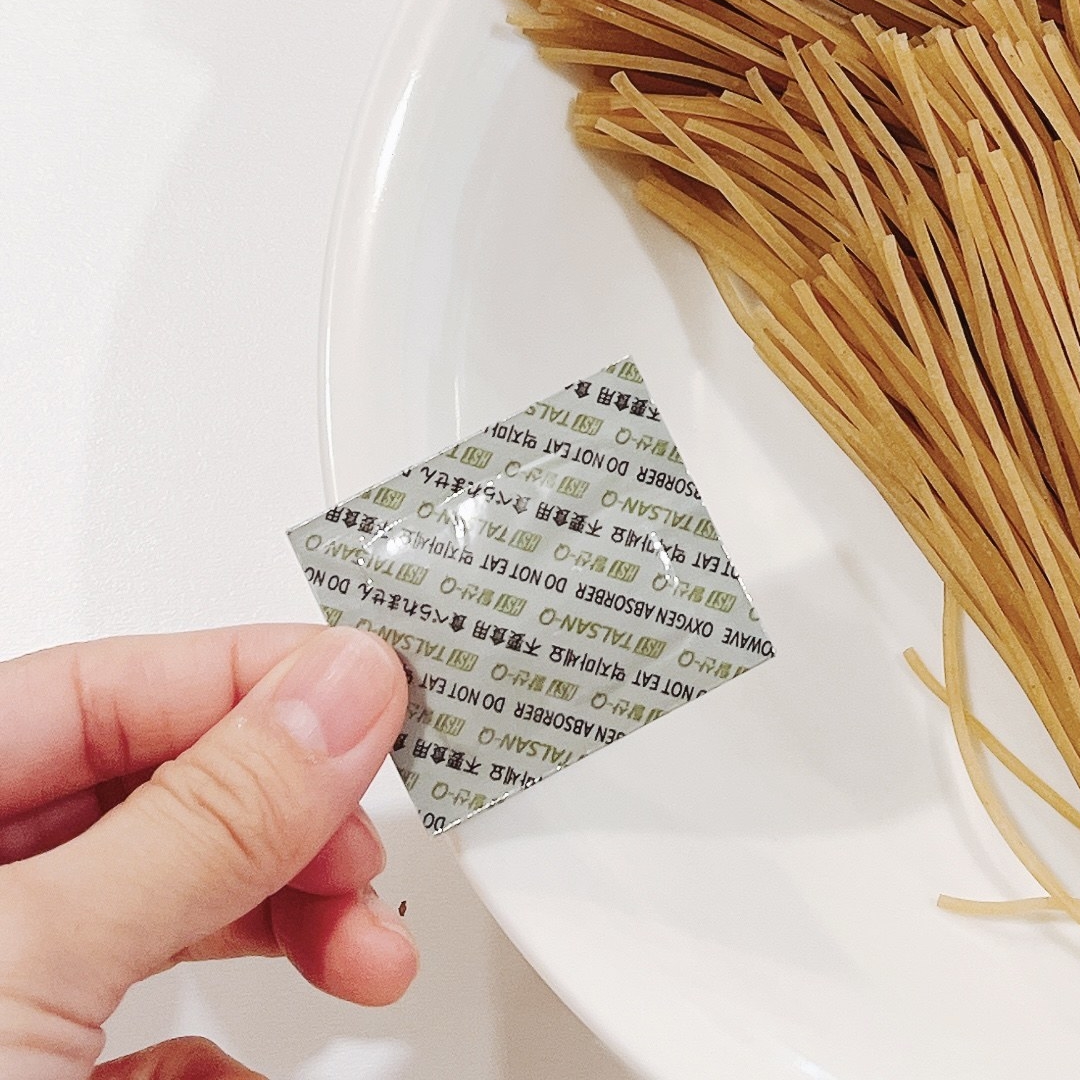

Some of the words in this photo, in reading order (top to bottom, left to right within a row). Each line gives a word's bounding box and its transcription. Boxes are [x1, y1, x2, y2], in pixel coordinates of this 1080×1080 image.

[459, 444, 492, 471] HST
[542, 436, 571, 460] EAT
[570, 444, 605, 470] NOT
[604, 455, 629, 477] DO
[371, 485, 406, 513] HST
[599, 487, 694, 533] TALSAN-Q
[534, 500, 604, 538] 不要食用
[507, 526, 542, 554] HST
[478, 551, 509, 575] EAT
[508, 560, 543, 586] NOT
[607, 557, 640, 584] HST
[691, 548, 720, 573] EAT
[325, 574, 350, 598] DO
[543, 571, 568, 593] DO
[354, 583, 467, 633] 食べられません
[492, 590, 526, 618] HST
[574, 580, 655, 620] ABSORBER
[704, 586, 736, 614] HST
[537, 604, 634, 650] TALSAN-Q
[654, 605, 715, 638] OXYGEN
[471, 619, 543, 656] 不要食用
[632, 633, 666, 660] HST
[445, 645, 478, 672] HST
[547, 642, 628, 683] 먹지마세요
[418, 671, 447, 694] EAT
[447, 680, 481, 705] NOT
[631, 668, 661, 693] EAT
[660, 676, 694, 703] NOT
[481, 690, 506, 712] DO
[512, 700, 594, 739] ABSORBER
[411, 737, 482, 775] 不要食用
